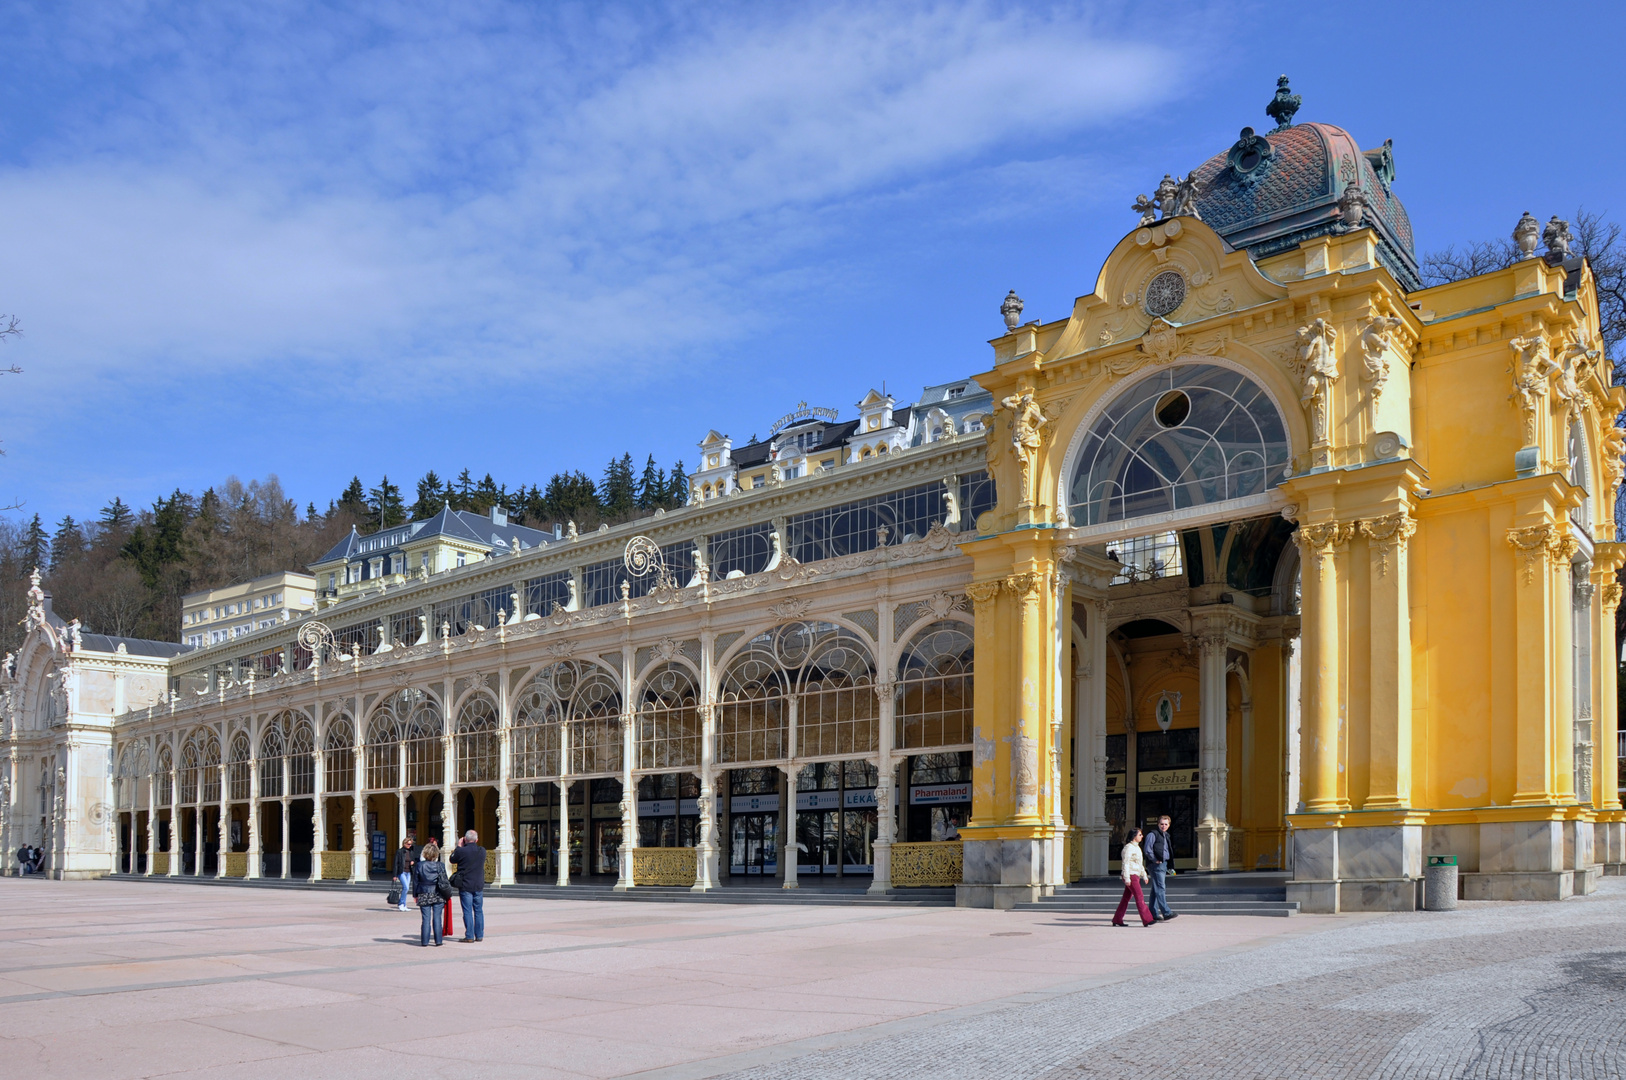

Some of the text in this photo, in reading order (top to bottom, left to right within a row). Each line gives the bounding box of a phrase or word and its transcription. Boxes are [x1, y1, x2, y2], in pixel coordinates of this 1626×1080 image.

[772, 413, 794, 432] HOTEL
[1150, 772, 1188, 785] Sasha
[915, 786, 967, 797] Pharmaland
